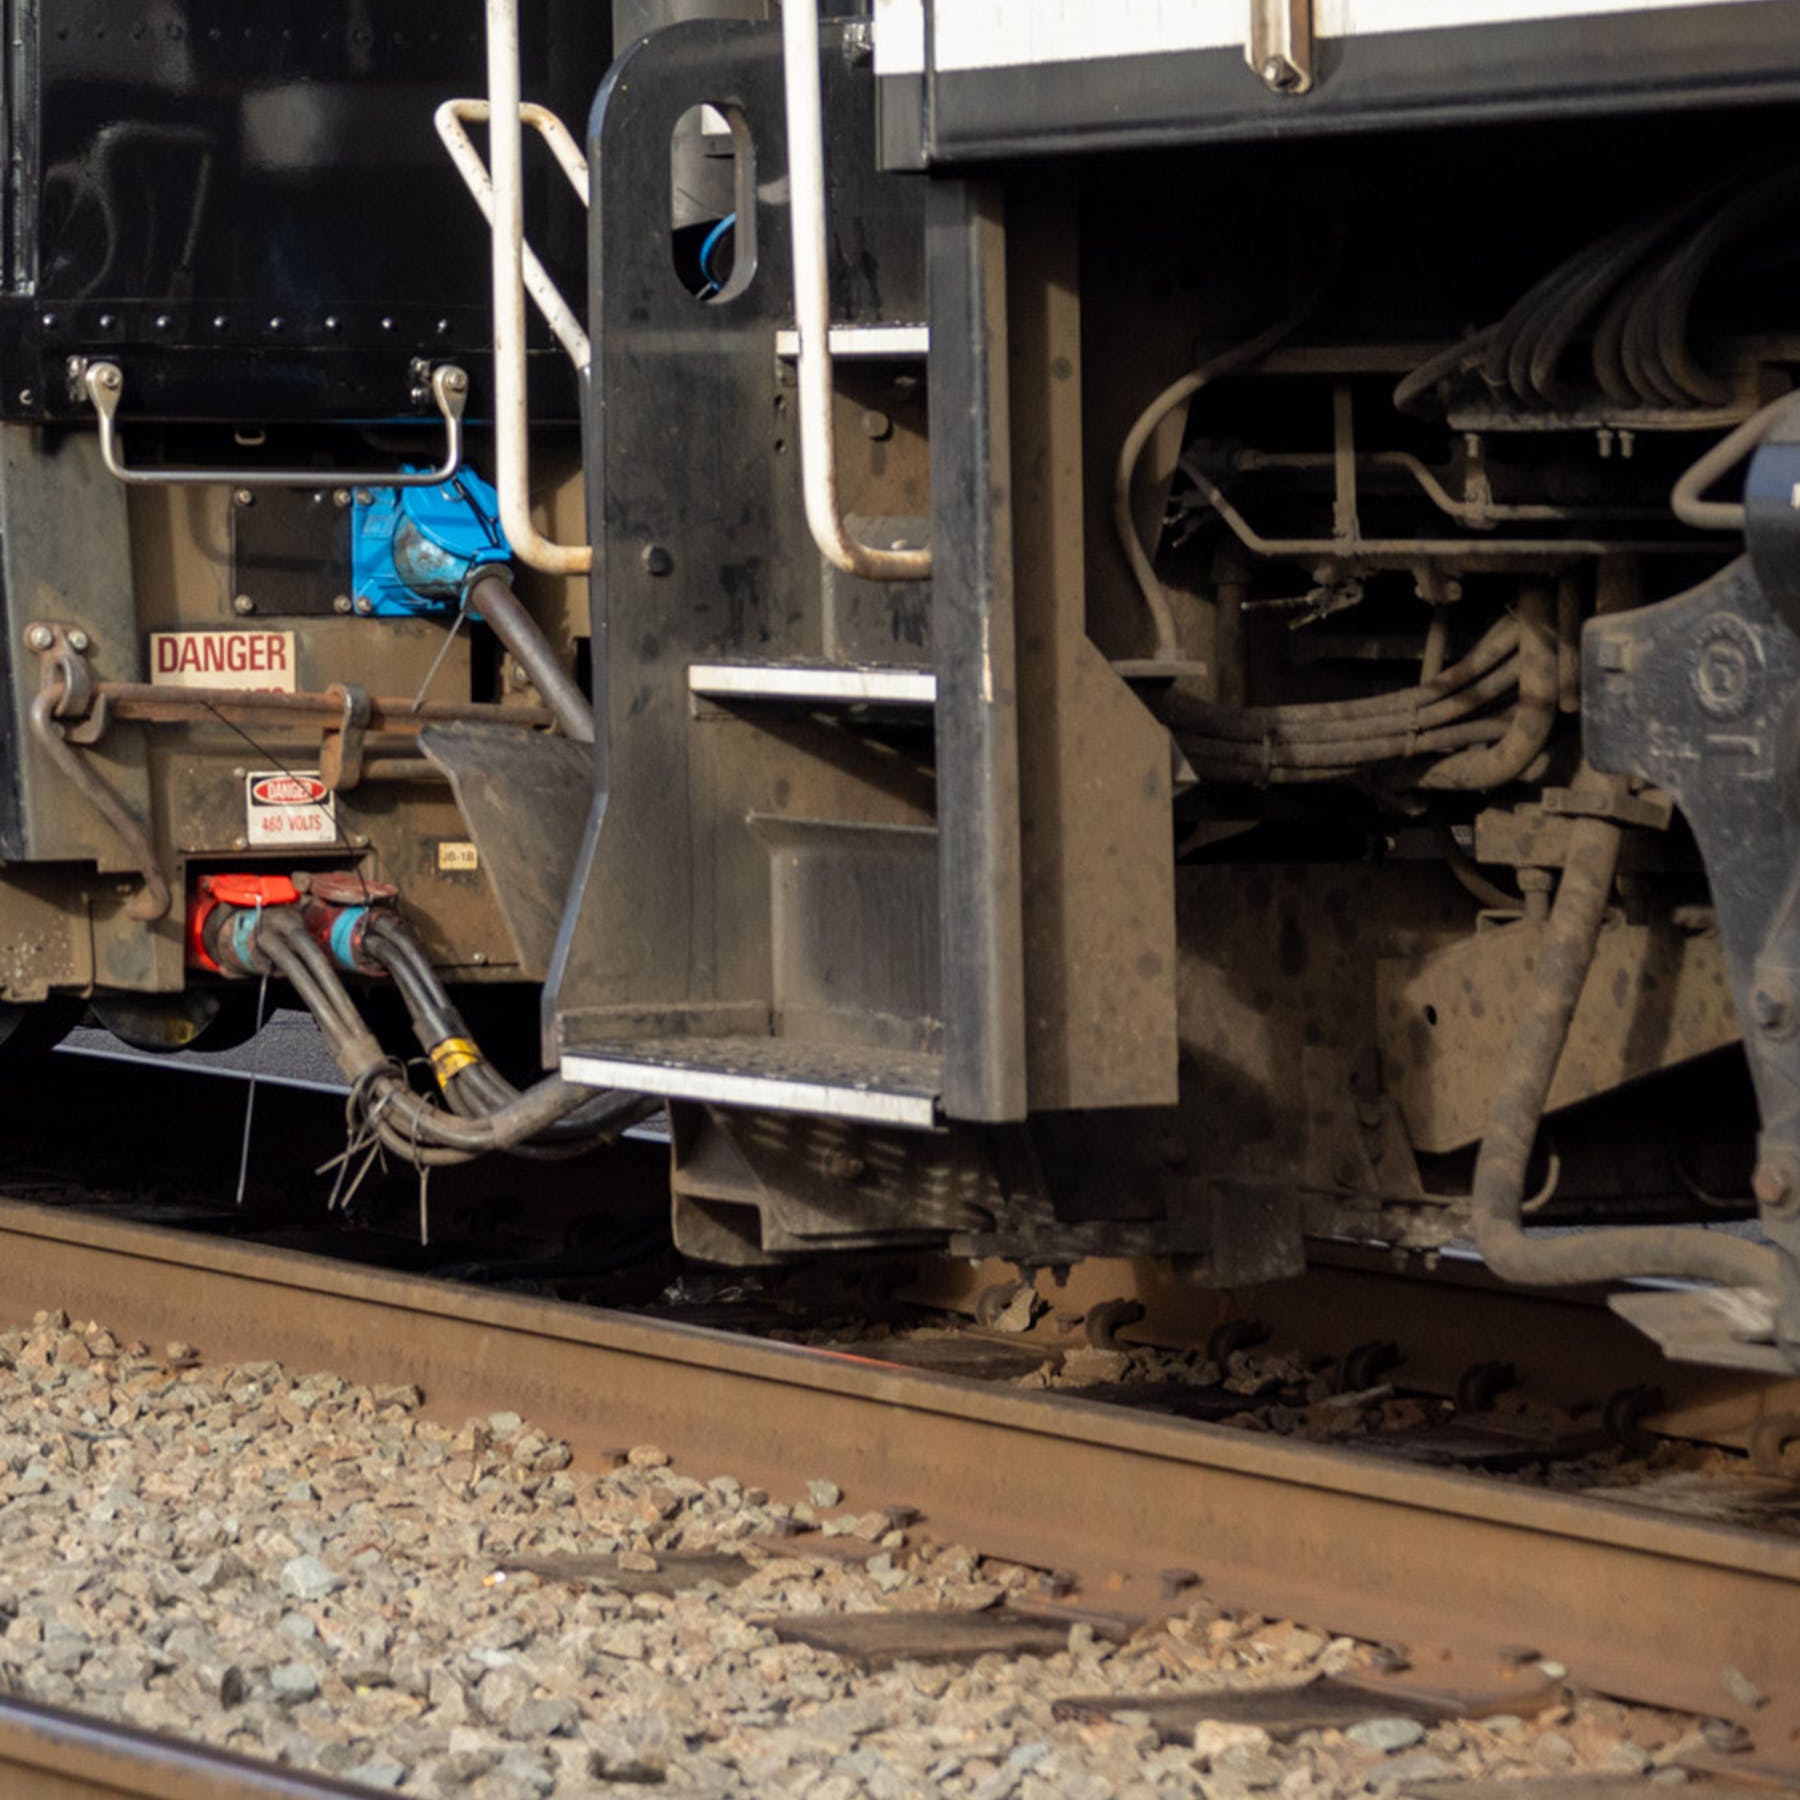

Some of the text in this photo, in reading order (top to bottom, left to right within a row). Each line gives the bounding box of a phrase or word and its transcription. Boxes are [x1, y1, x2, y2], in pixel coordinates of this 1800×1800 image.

[157, 634, 287, 673] DANGER
[267, 782, 312, 800] DANGER
[288, 814, 321, 832] VOLTS
